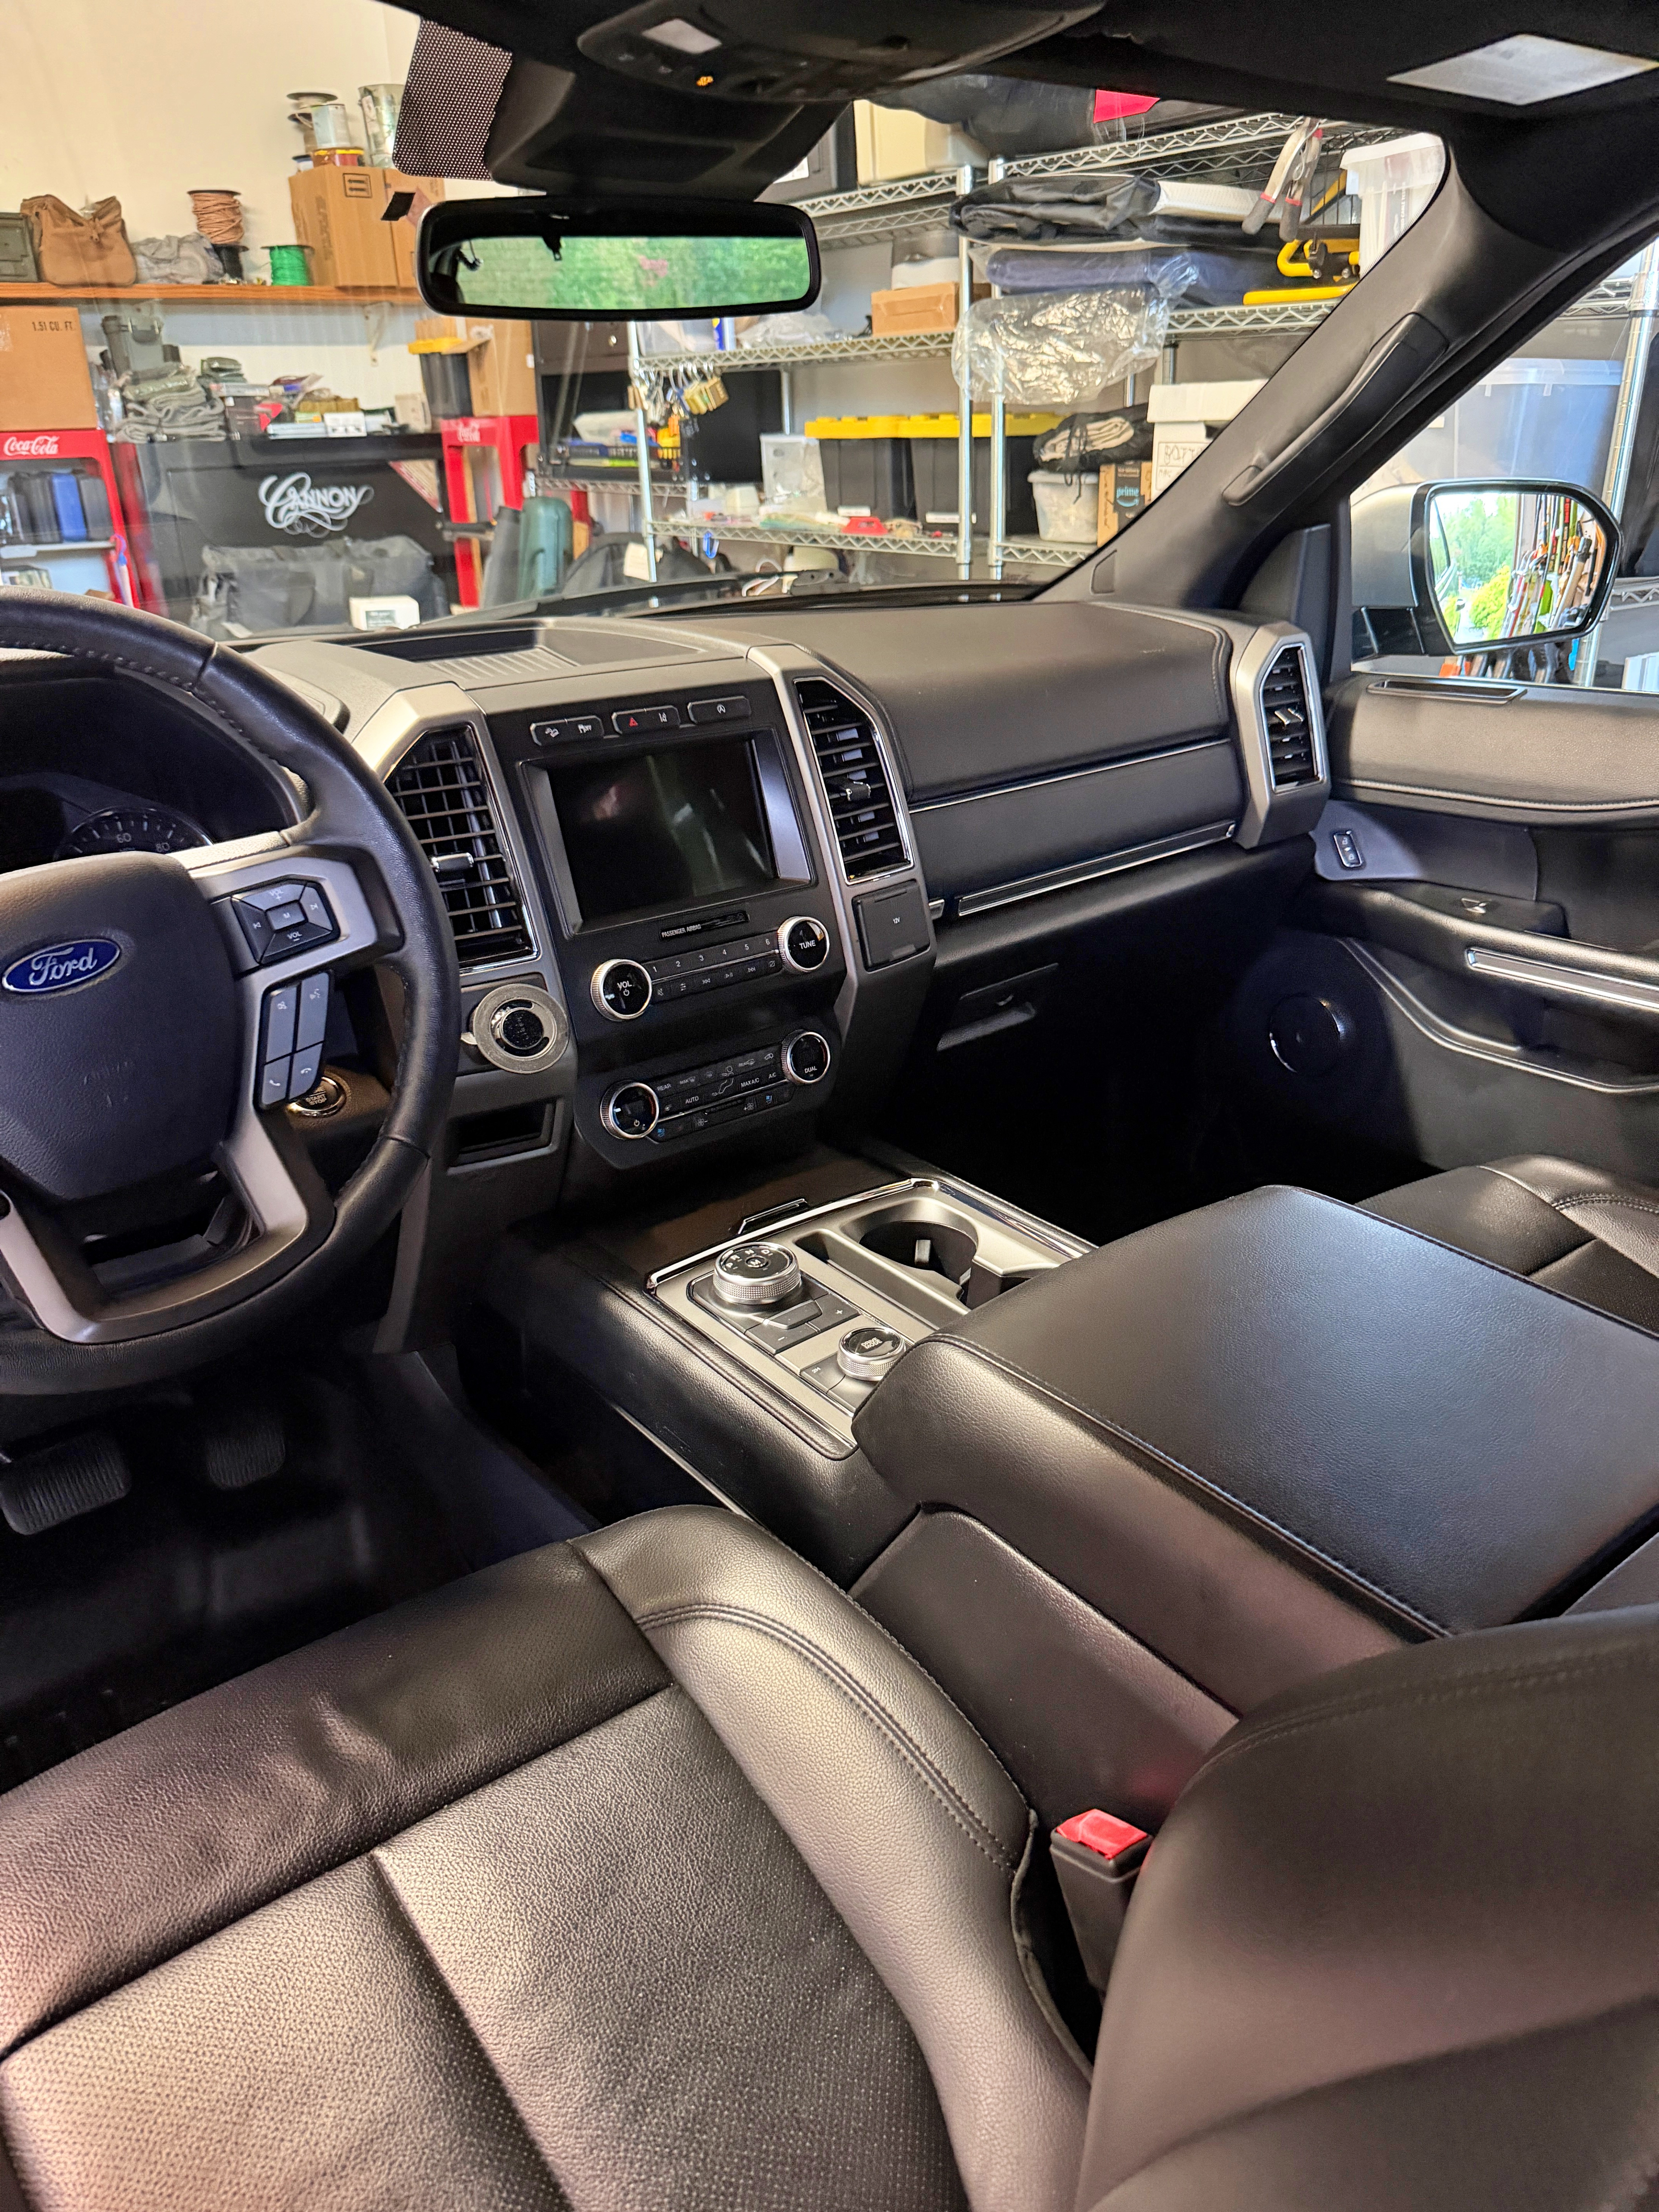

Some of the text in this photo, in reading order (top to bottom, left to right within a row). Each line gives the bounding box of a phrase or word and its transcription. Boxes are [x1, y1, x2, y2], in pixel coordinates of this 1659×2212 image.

[32, 321, 47, 331] 1.51
[1116, 486, 1140, 499] prime
[259, 472, 374, 538] CANNON
[117, 833, 132, 843] 60
[156, 842, 170, 852] 80
[270, 888, 283, 896] VOL
[287, 931, 302, 939] VOL
[661, 924, 701, 938] PASSENGER AIRBAG
[799, 940, 816, 950] TUNE
[29, 947, 98, 986] Ford
[617, 981, 632, 991] VOL
[685, 1096, 699, 1104] AUTO
[861, 1337, 878, 1346] DRIVE
[864, 1340, 883, 1349] MODE
